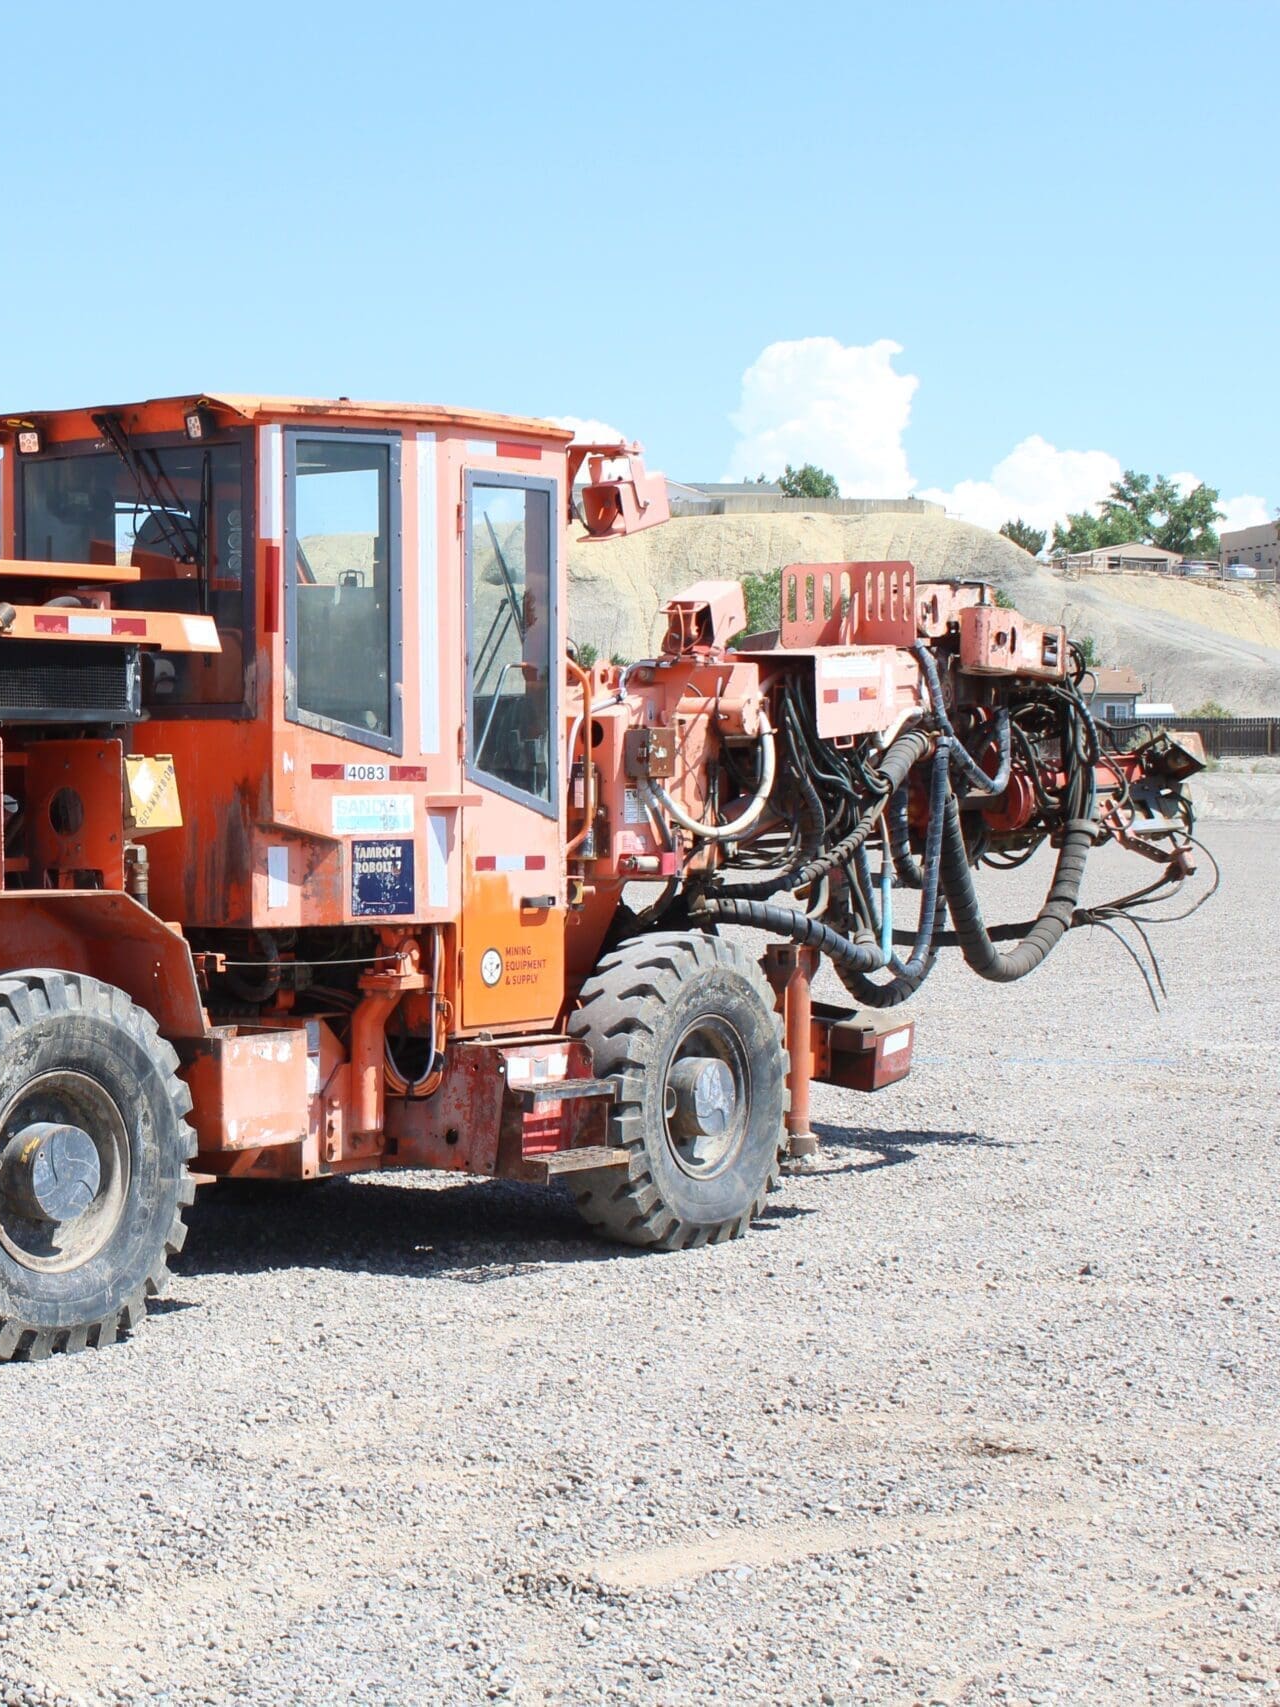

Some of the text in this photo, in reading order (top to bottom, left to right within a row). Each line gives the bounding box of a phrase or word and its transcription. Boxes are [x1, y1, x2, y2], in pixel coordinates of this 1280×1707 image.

[348, 766, 385, 780] 4083
[354, 846, 402, 858] TAMROCK
[353, 861, 392, 873] ROBOLT
[505, 946, 531, 956] MINING
[505, 959, 546, 971] EQUIPMENT
[505, 974, 538, 985] & SUPPLY
